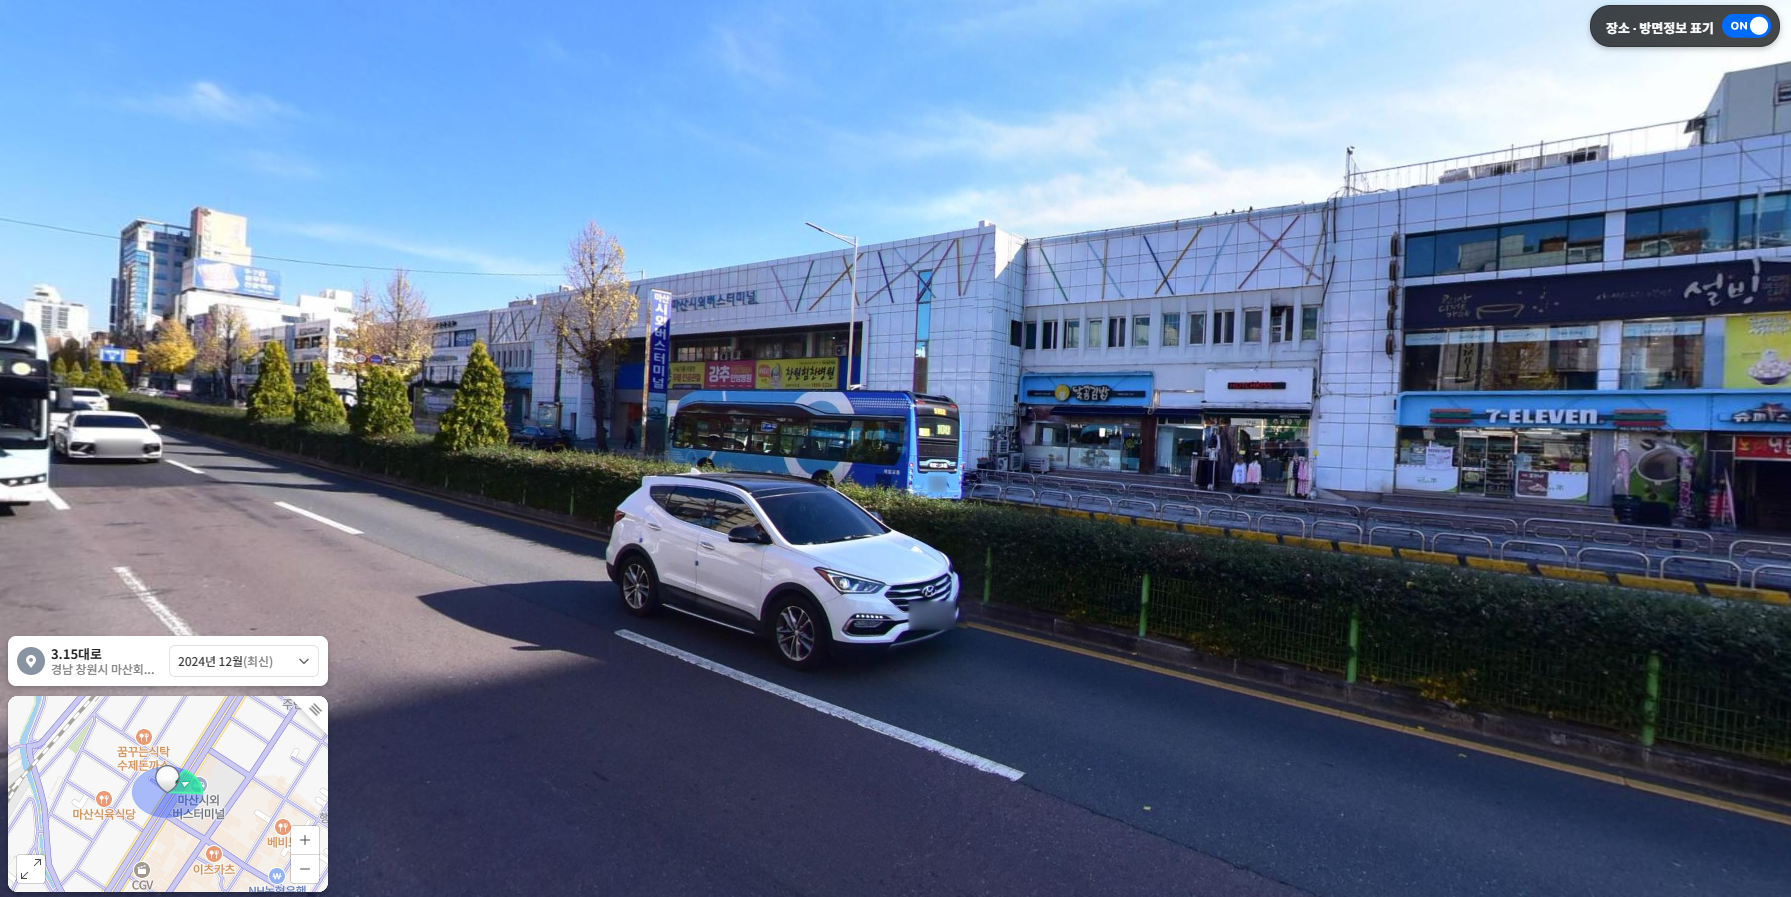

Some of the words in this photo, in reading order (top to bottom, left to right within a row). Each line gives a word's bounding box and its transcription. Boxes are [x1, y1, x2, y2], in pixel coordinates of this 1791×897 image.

[654, 292, 670, 304] 마산
[672, 289, 759, 312] 마산시외버스터미널
[652, 303, 669, 390] 시외버스터미널
[785, 365, 835, 381] 창원힘찬병원
